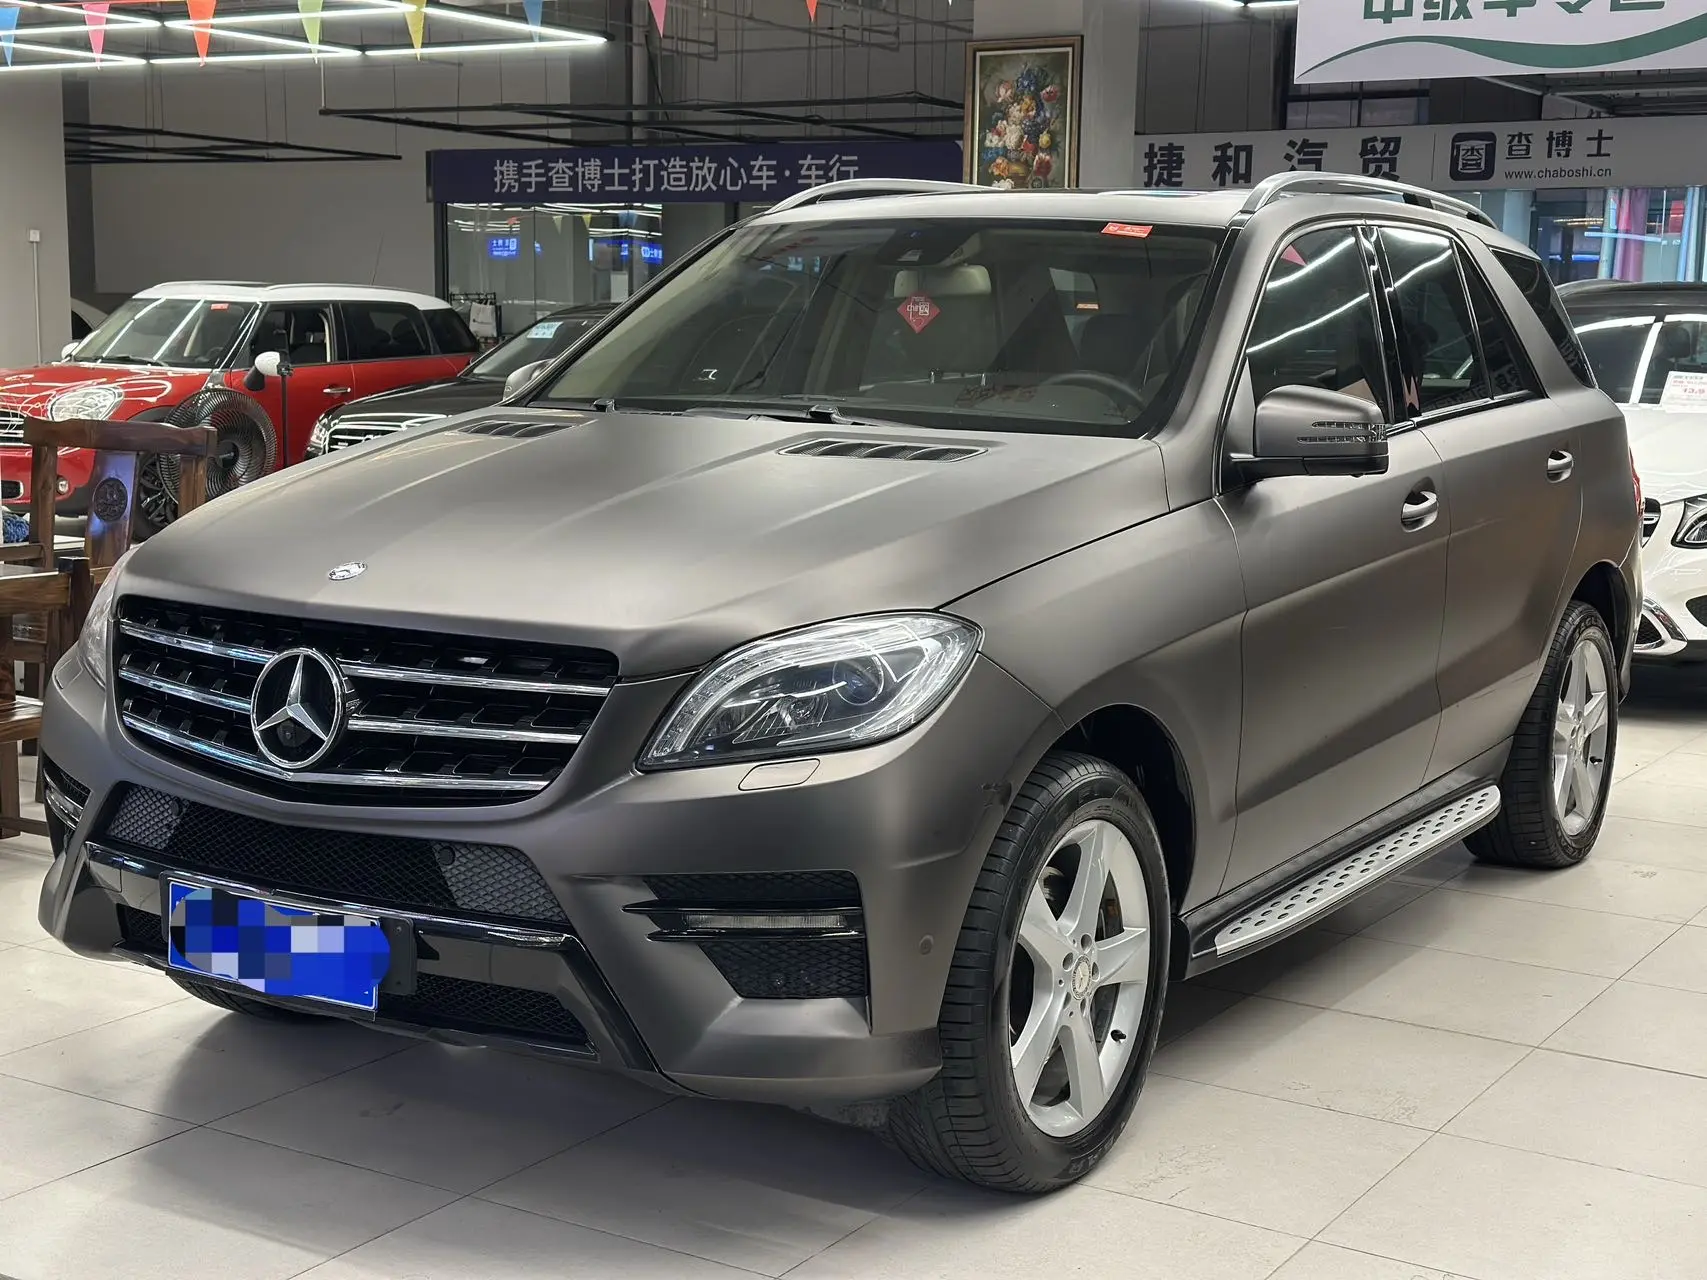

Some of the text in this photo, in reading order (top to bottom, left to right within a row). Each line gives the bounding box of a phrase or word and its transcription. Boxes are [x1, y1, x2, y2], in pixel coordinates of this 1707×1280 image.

[1144, 135, 1402, 188] 捷和汽贸
[1505, 129, 1614, 160] 查博士
[493, 154, 860, 193] 携手查博士打造放心车·车行
[1504, 165, 1613, 179] www.chaboshi.cn
